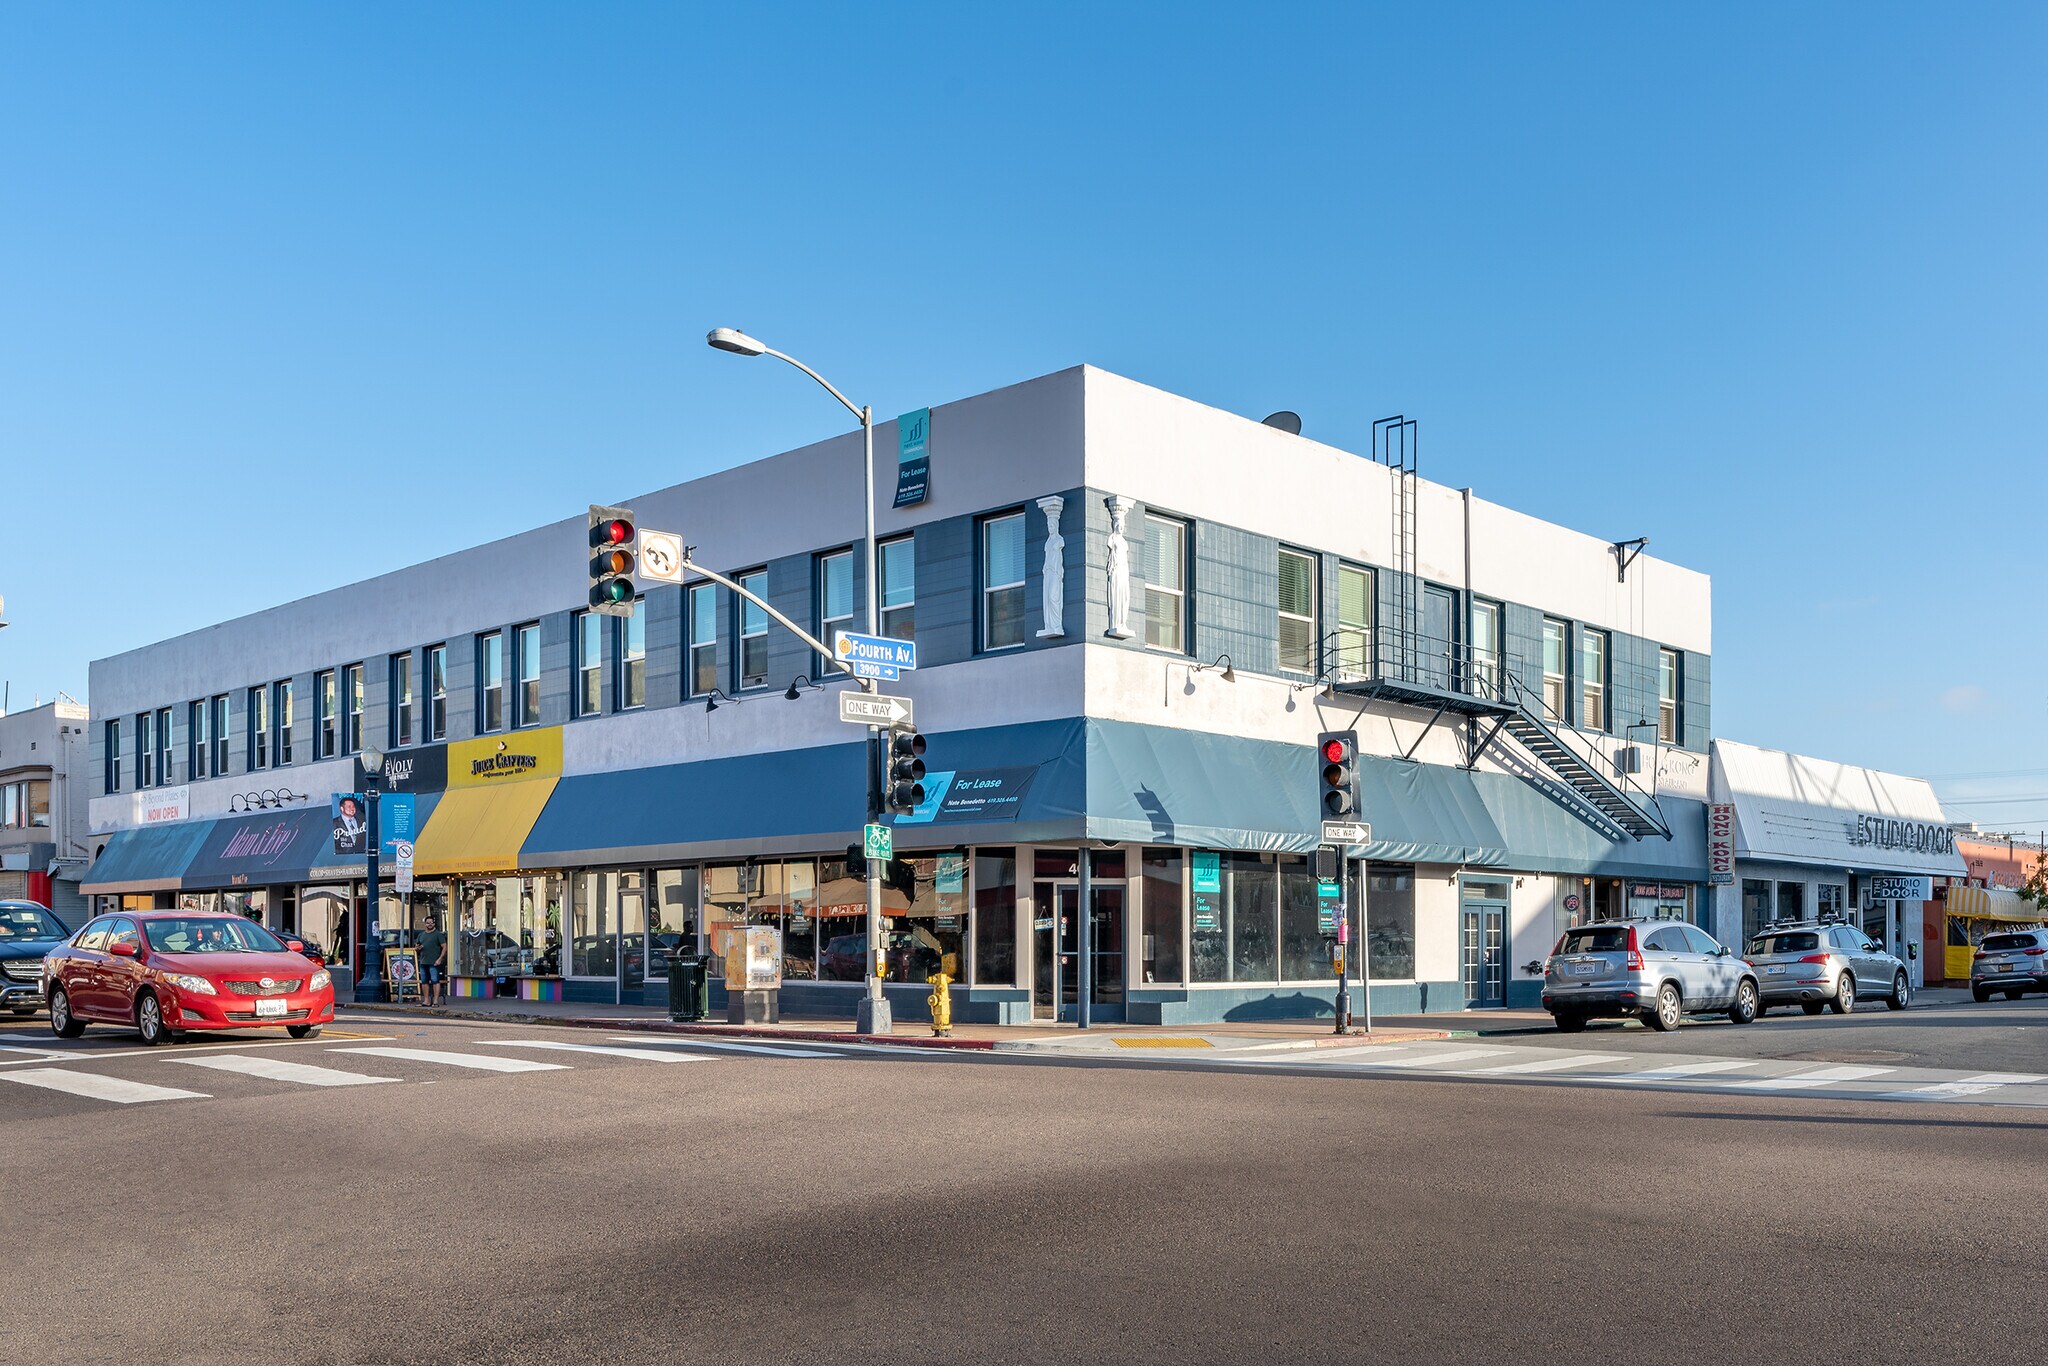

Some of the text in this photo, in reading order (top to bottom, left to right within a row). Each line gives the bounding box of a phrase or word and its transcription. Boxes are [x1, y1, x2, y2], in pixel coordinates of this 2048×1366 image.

[900, 467, 926, 479] For Lease
[852, 640, 912, 664] FOURTH AV.
[860, 664, 880, 676] 3900
[848, 702, 891, 716] ONE WAY
[472, 752, 536, 775] JUICE CRAFTERS
[955, 778, 1002, 791] For Lease
[986, 796, 1018, 804] 619.326.4400
[148, 806, 178, 821] NOW OPEN
[334, 822, 366, 840] Proud
[1328, 829, 1356, 838] ONE WAY
[1865, 816, 1914, 850] STUDIO
[1916, 823, 1954, 854] DOOR
[1713, 806, 1730, 872] HONG KONG
[1882, 878, 1920, 888] STUDIO
[1882, 888, 1920, 898] DOOR
